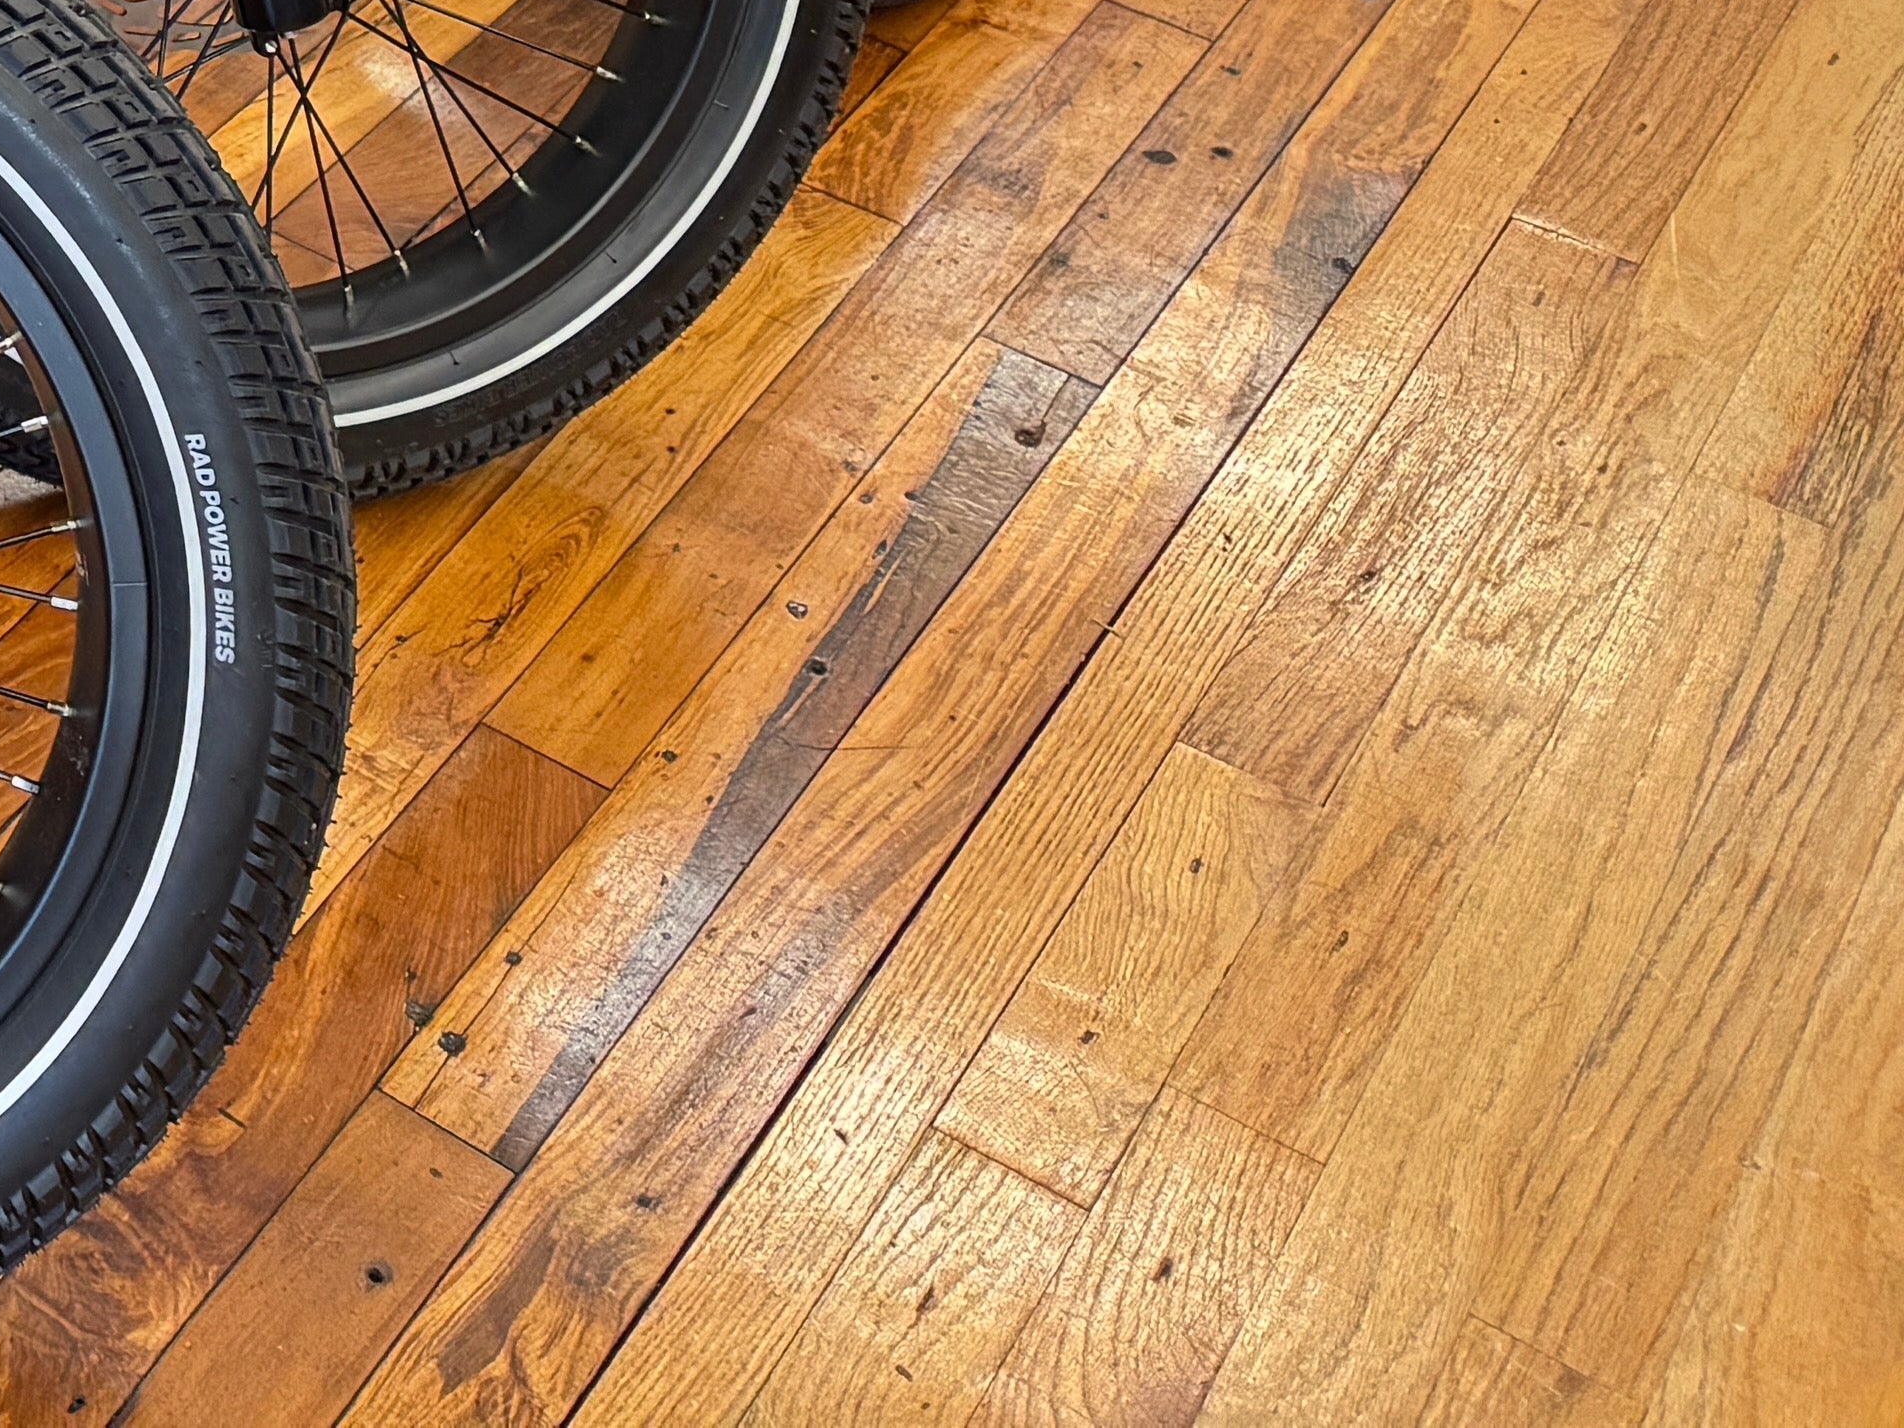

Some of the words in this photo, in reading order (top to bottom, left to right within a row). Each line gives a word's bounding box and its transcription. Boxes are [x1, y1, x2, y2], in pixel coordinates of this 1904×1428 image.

[183, 432, 215, 486] RAD
[199, 489, 233, 583] POWER
[211, 586, 235, 664] BIKES
